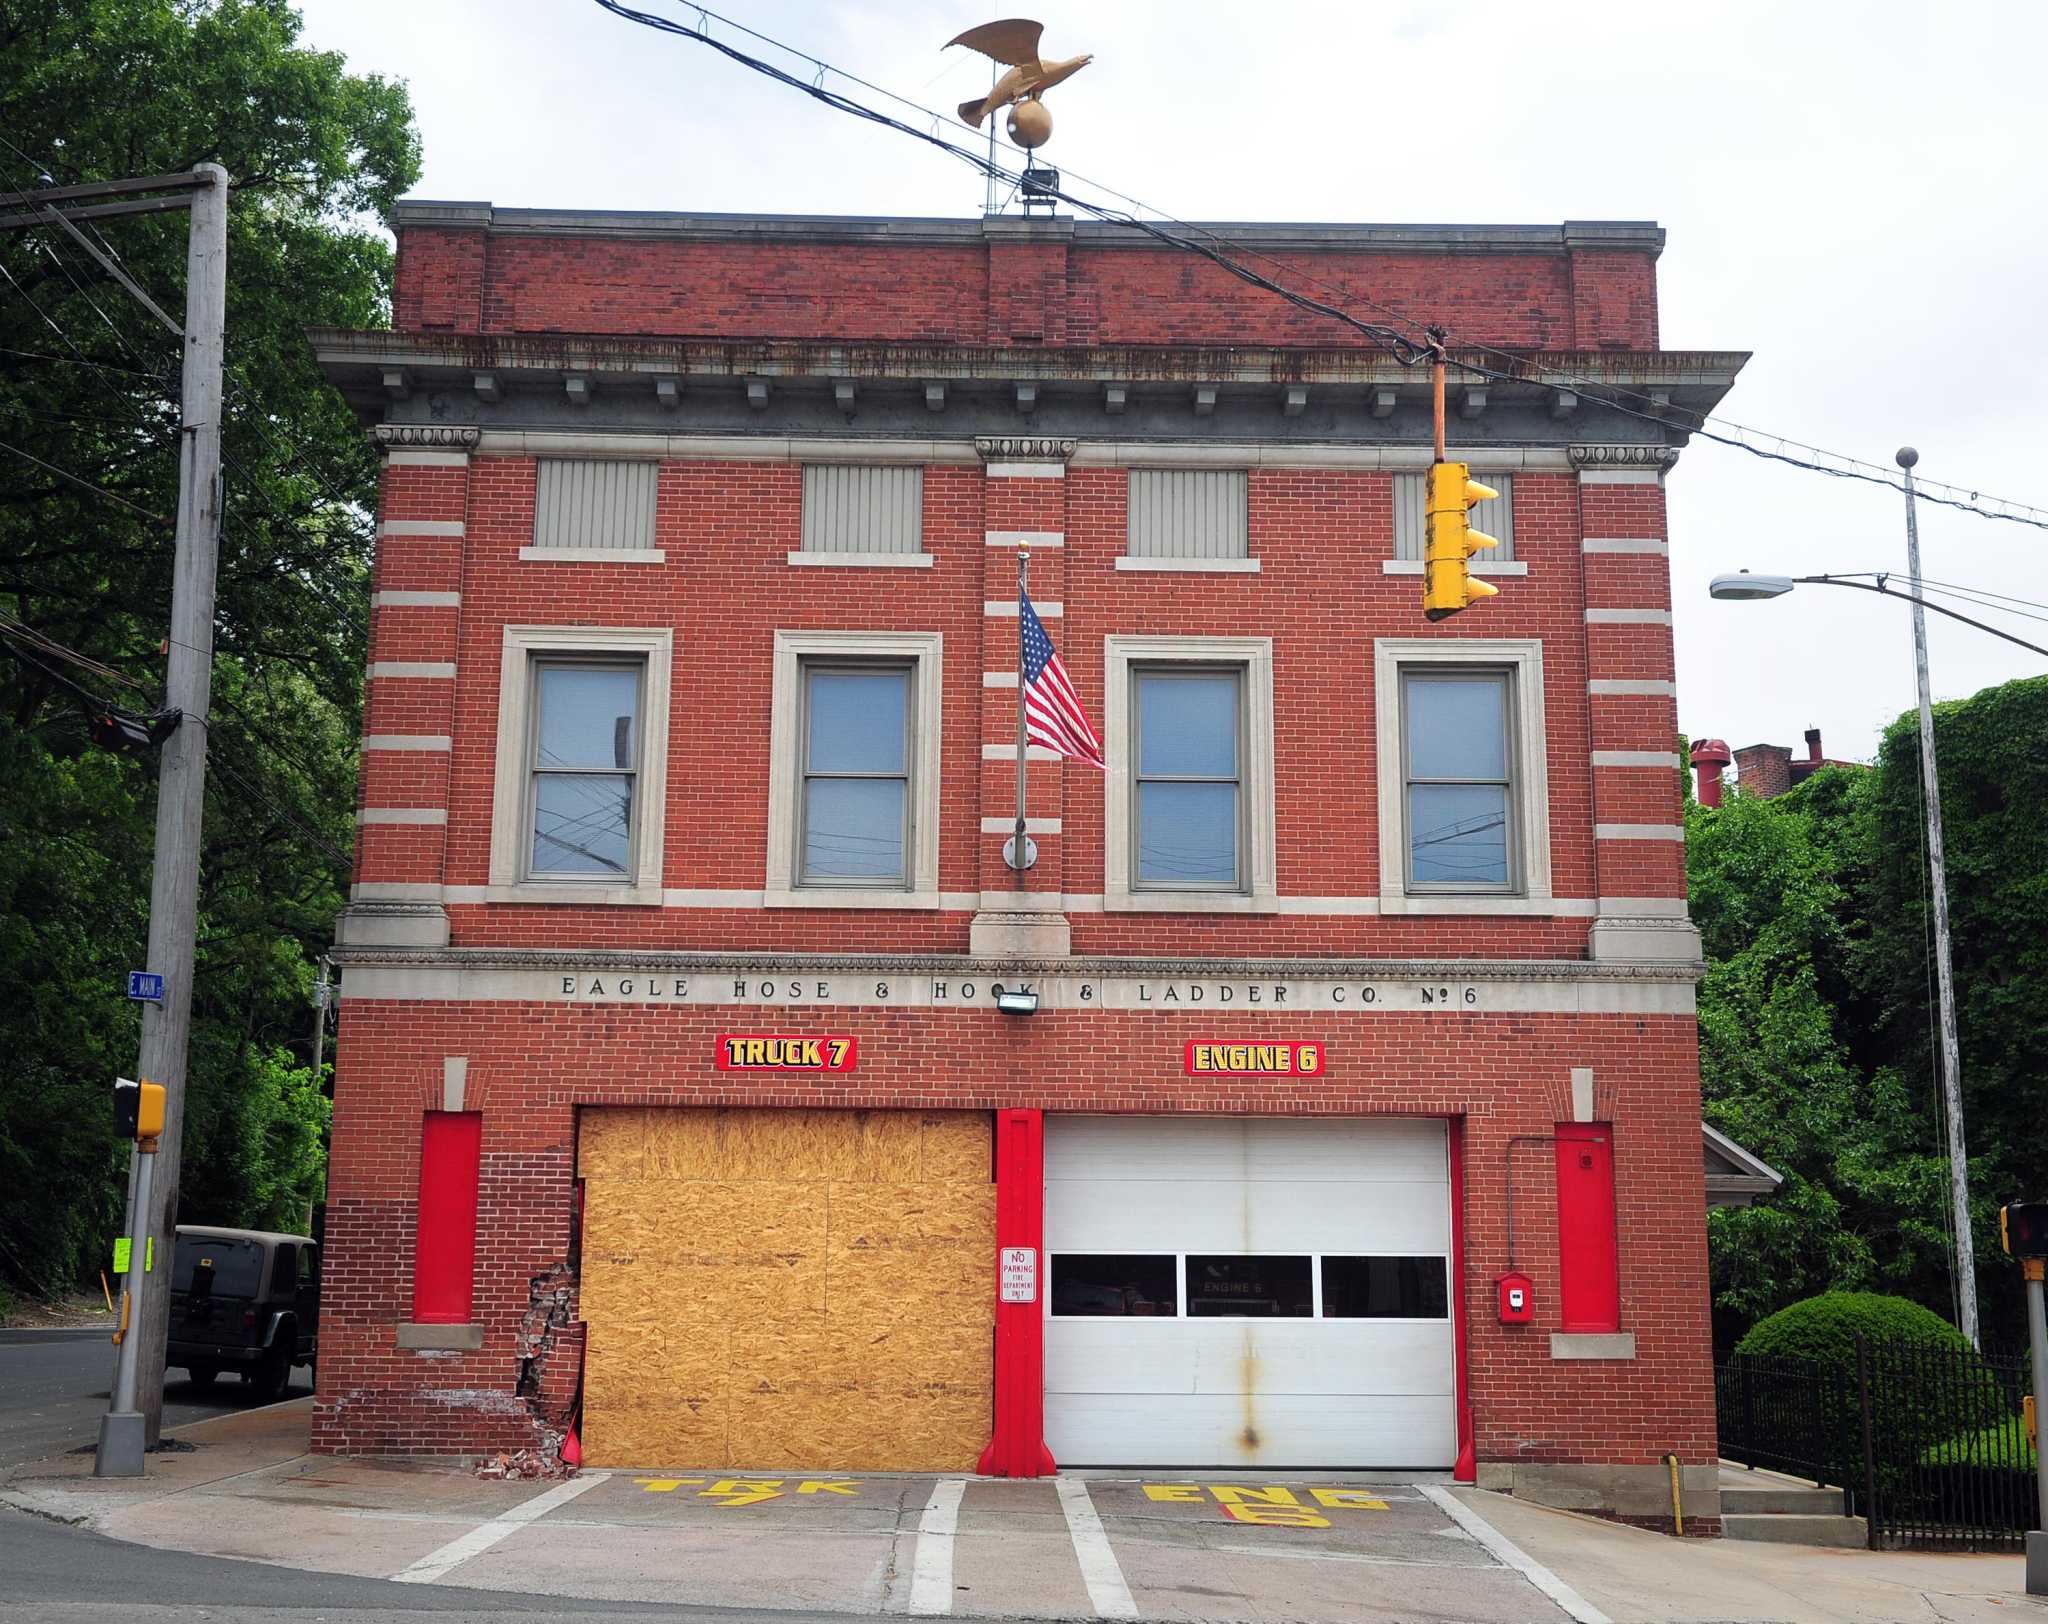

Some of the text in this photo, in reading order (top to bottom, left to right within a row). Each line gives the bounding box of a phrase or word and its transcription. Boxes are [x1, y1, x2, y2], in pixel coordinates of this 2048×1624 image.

[139, 975, 156, 996] MAIN
[562, 977, 688, 997] EAGLE
[733, 980, 830, 998] HOSE
[875, 982, 889, 999] &
[1080, 984, 1093, 1001] &
[1138, 984, 1288, 1003] LADDER
[1332, 986, 1383, 1003] CO.
[725, 1038, 850, 1068] TRUCK 7
[1193, 1045, 1318, 1073] ENGINE 6
[1003, 1265, 1033, 1273] PARKING
[1011, 1253, 1025, 1263] NO
[1203, 1281, 1249, 1293] ENGINE
[1141, 1485, 1392, 1511] ENG
